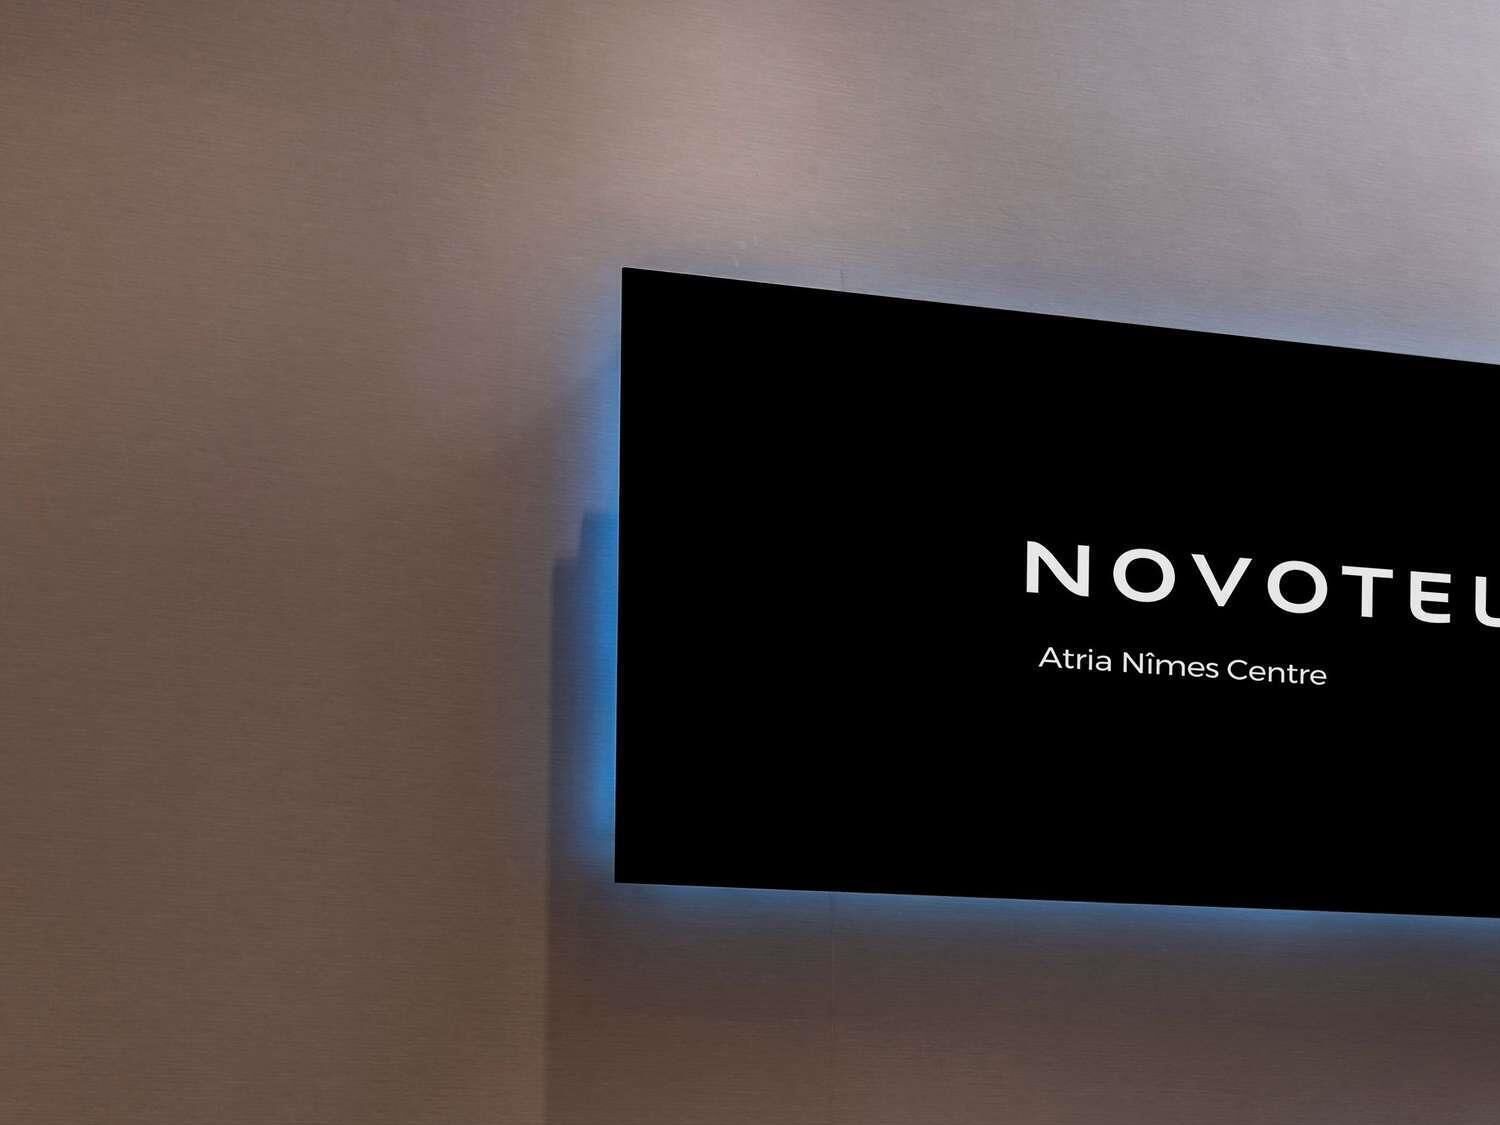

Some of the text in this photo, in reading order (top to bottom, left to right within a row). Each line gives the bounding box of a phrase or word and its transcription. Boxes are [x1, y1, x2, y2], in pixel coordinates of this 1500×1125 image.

[1038, 646, 1328, 686] Atria Nîmes Centre
